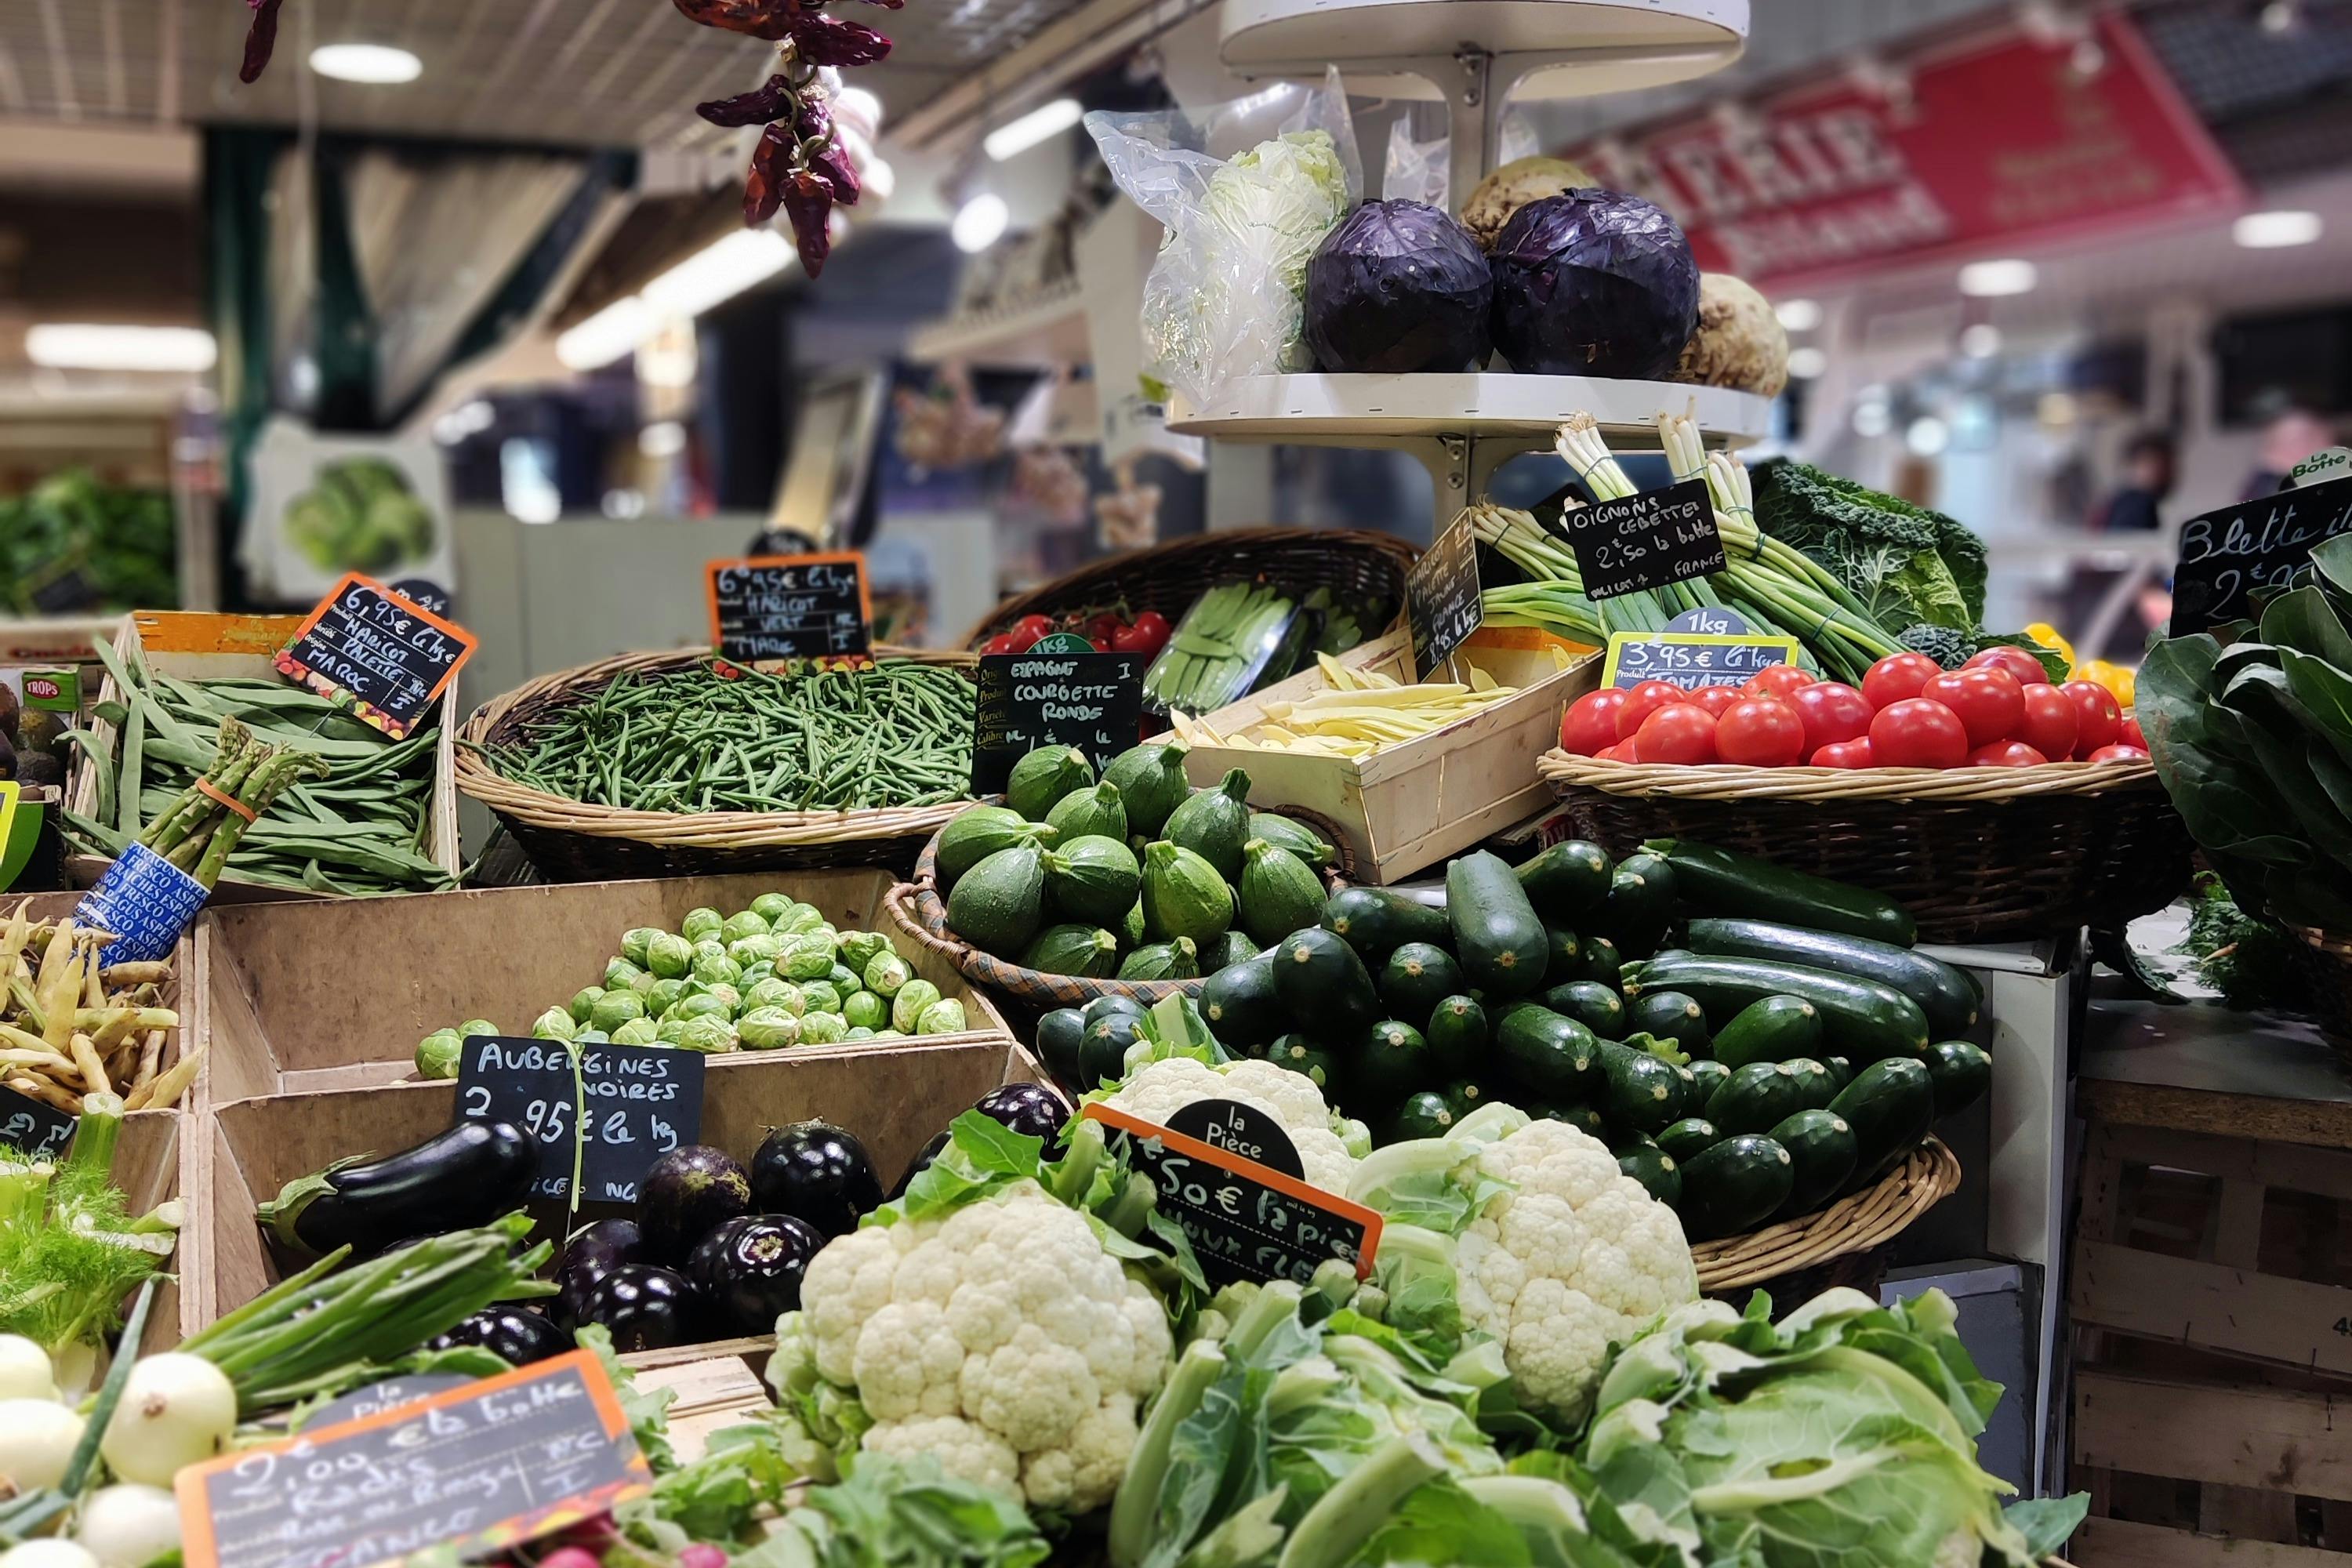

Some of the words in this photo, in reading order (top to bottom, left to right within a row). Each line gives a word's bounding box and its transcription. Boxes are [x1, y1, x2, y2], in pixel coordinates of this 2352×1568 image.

[2292, 456, 2347, 477] Botte
[1676, 518, 1715, 544] botte
[2181, 503, 2321, 564] Blette
[1675, 551, 1723, 577] FRANCE
[1687, 611, 1730, 635] 1kg
[344, 618, 409, 663] HARICOT
[342, 638, 405, 680] PALETTE
[1617, 669, 1646, 679] Produit
[26, 680, 59, 696] TROPS
[1014, 683, 1118, 702] COURGETTE
[1041, 702, 1104, 722] RONDE
[110, 860, 163, 900] FRAICHES
[127, 854, 171, 888] FRESCO
[118, 883, 164, 917] FRESCO
[583, 1079, 680, 1102] NOIRES
[601, 1110, 637, 1145] le
[1228, 1105, 1245, 1131] la
[1206, 1121, 1263, 1160] Pièce
[2332, 1316, 2352, 1337] 4
